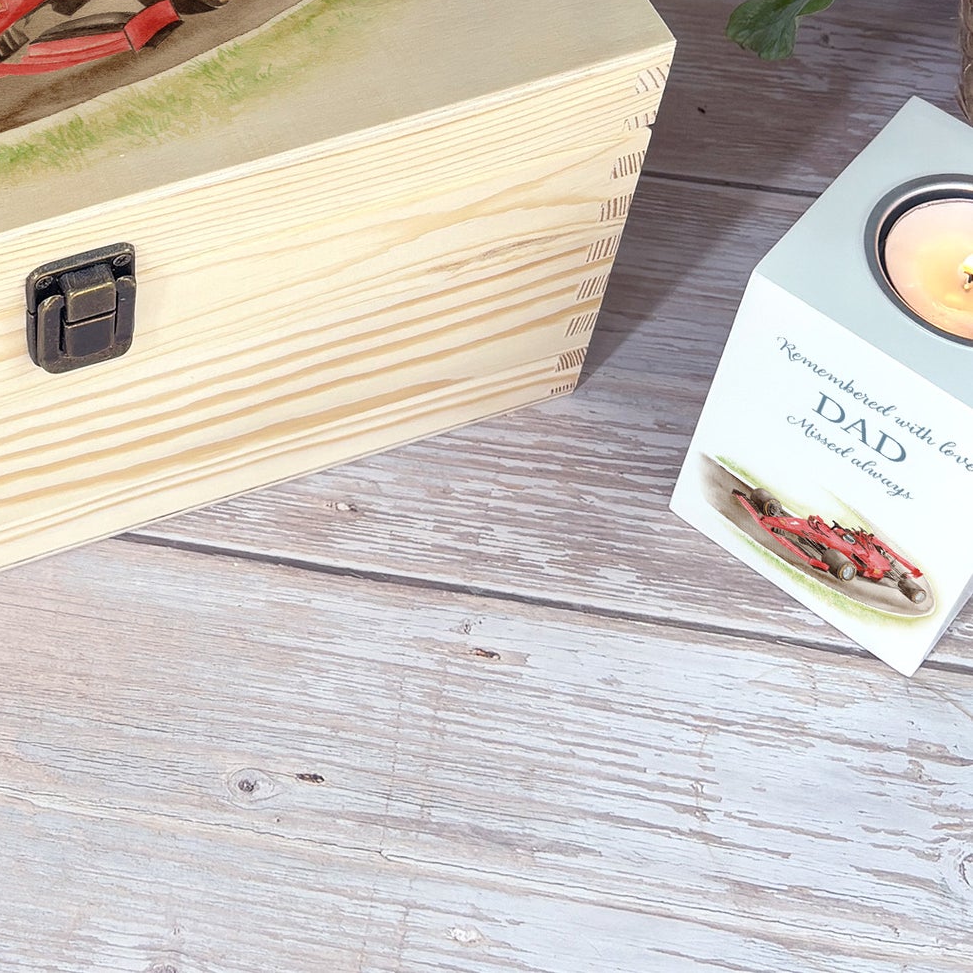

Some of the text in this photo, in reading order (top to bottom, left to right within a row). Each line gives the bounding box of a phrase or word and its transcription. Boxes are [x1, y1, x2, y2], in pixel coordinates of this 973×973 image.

[777, 336, 973, 472] Remembered with love
[811, 391, 907, 463] DAD
[786, 414, 914, 500] Missed always
